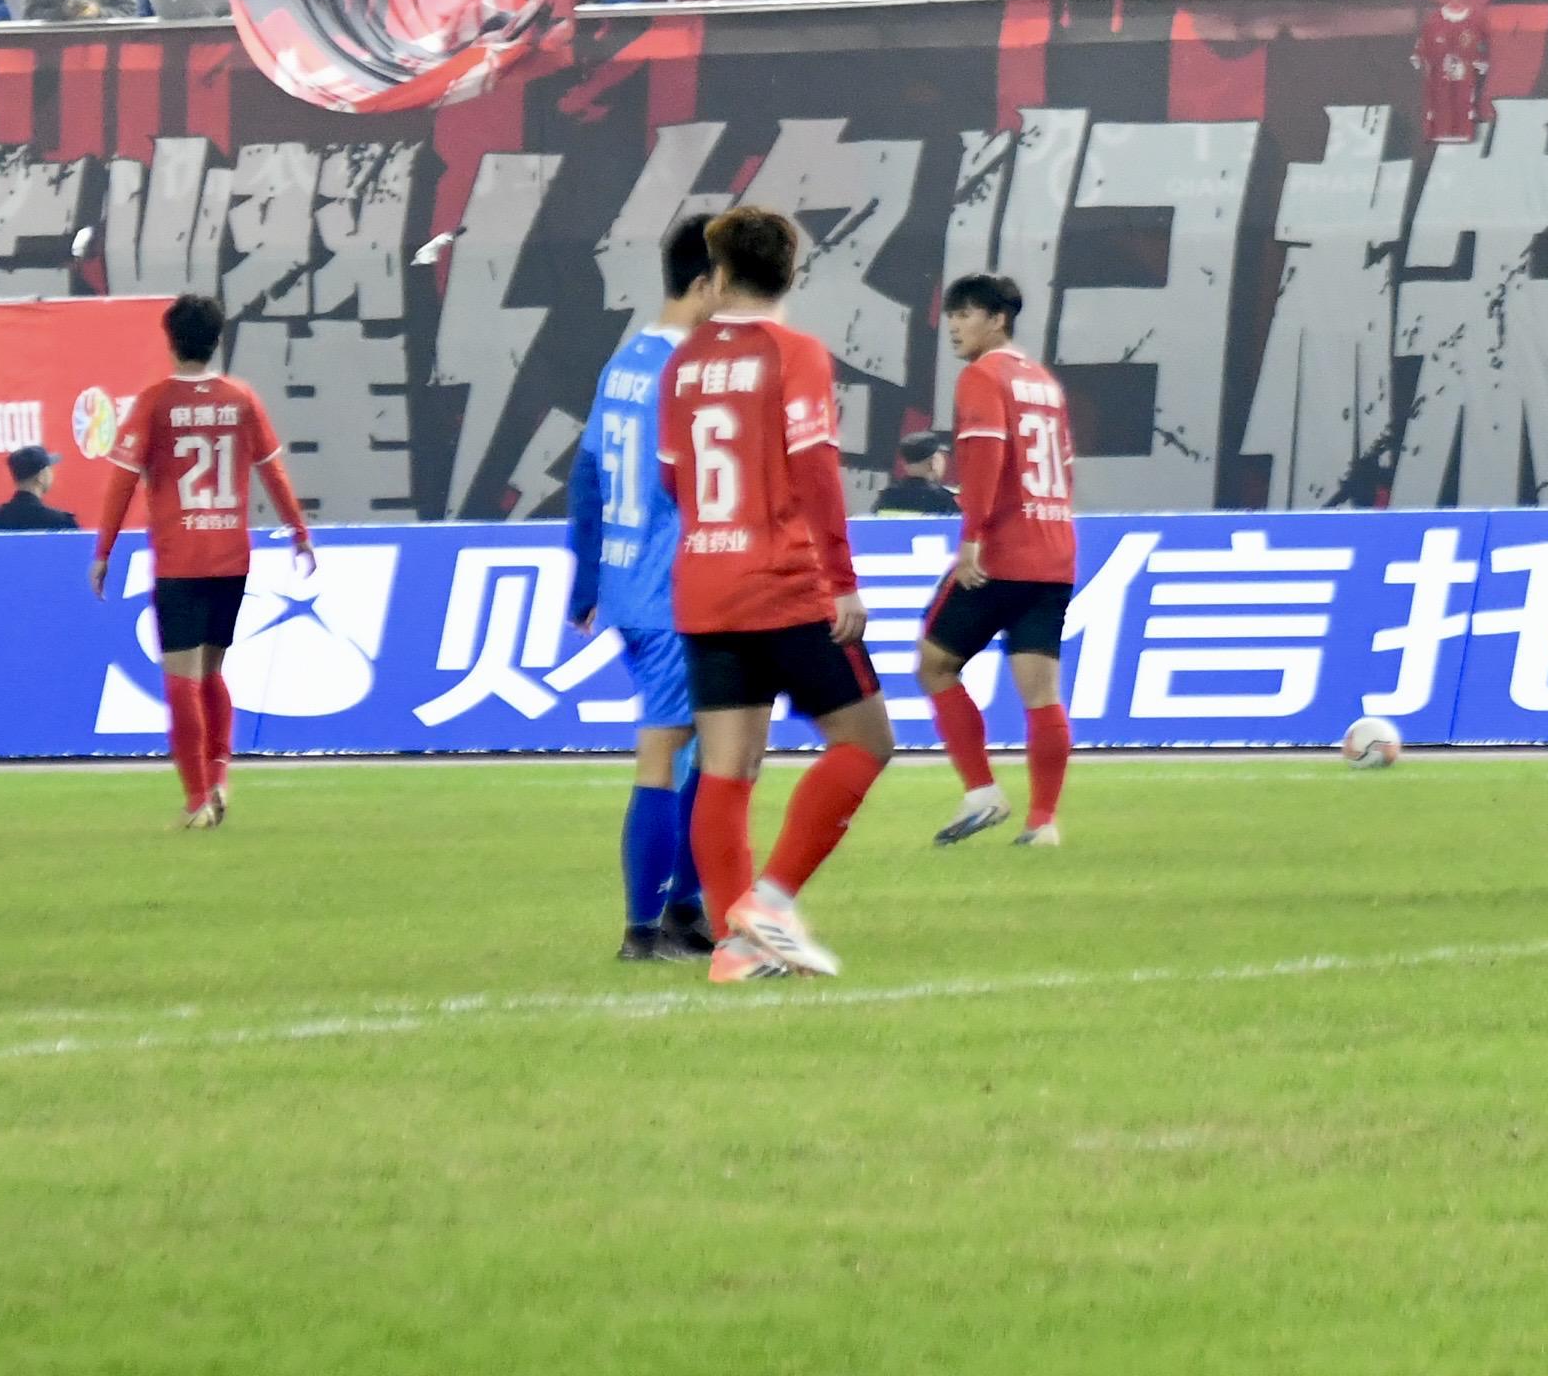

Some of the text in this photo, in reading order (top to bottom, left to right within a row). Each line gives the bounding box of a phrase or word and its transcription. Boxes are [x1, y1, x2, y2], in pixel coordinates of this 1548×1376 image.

[172, 433, 239, 512] 21
[690, 403, 741, 523] 6
[1018, 412, 1070, 500] 31
